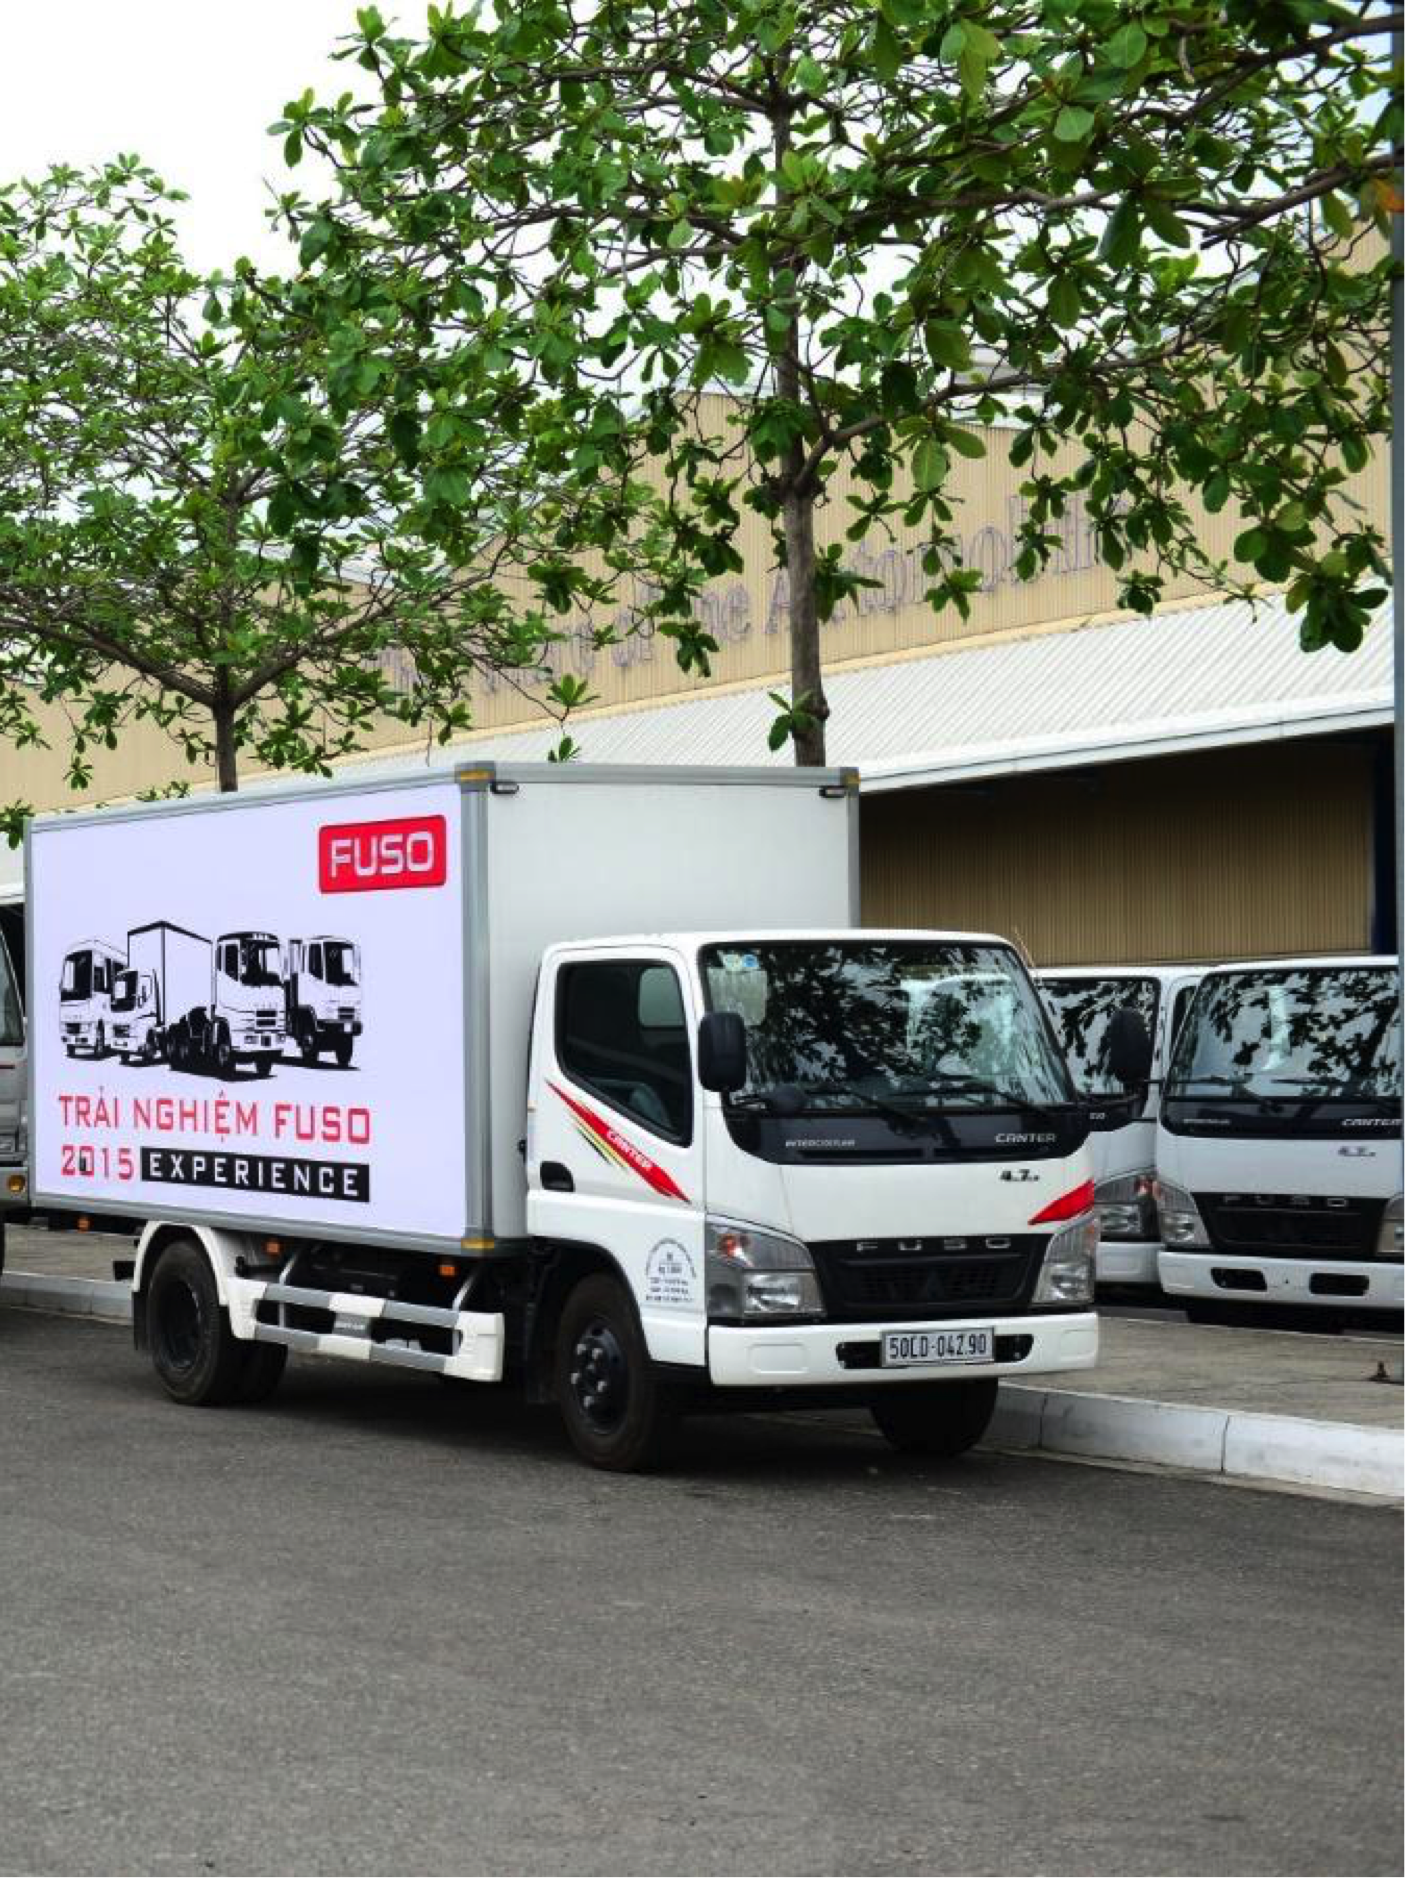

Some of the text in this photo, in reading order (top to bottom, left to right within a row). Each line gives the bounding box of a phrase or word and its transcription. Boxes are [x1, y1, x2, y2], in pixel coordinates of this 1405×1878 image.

[331, 831, 434, 878] FUSO
[59, 1086, 370, 1144] TRẢI NGHIỆM FUSO
[995, 1132, 1058, 1143] CANTER
[60, 1144, 360, 1197] 2015 EXPERIENCE
[856, 1237, 1012, 1252] FUSO
